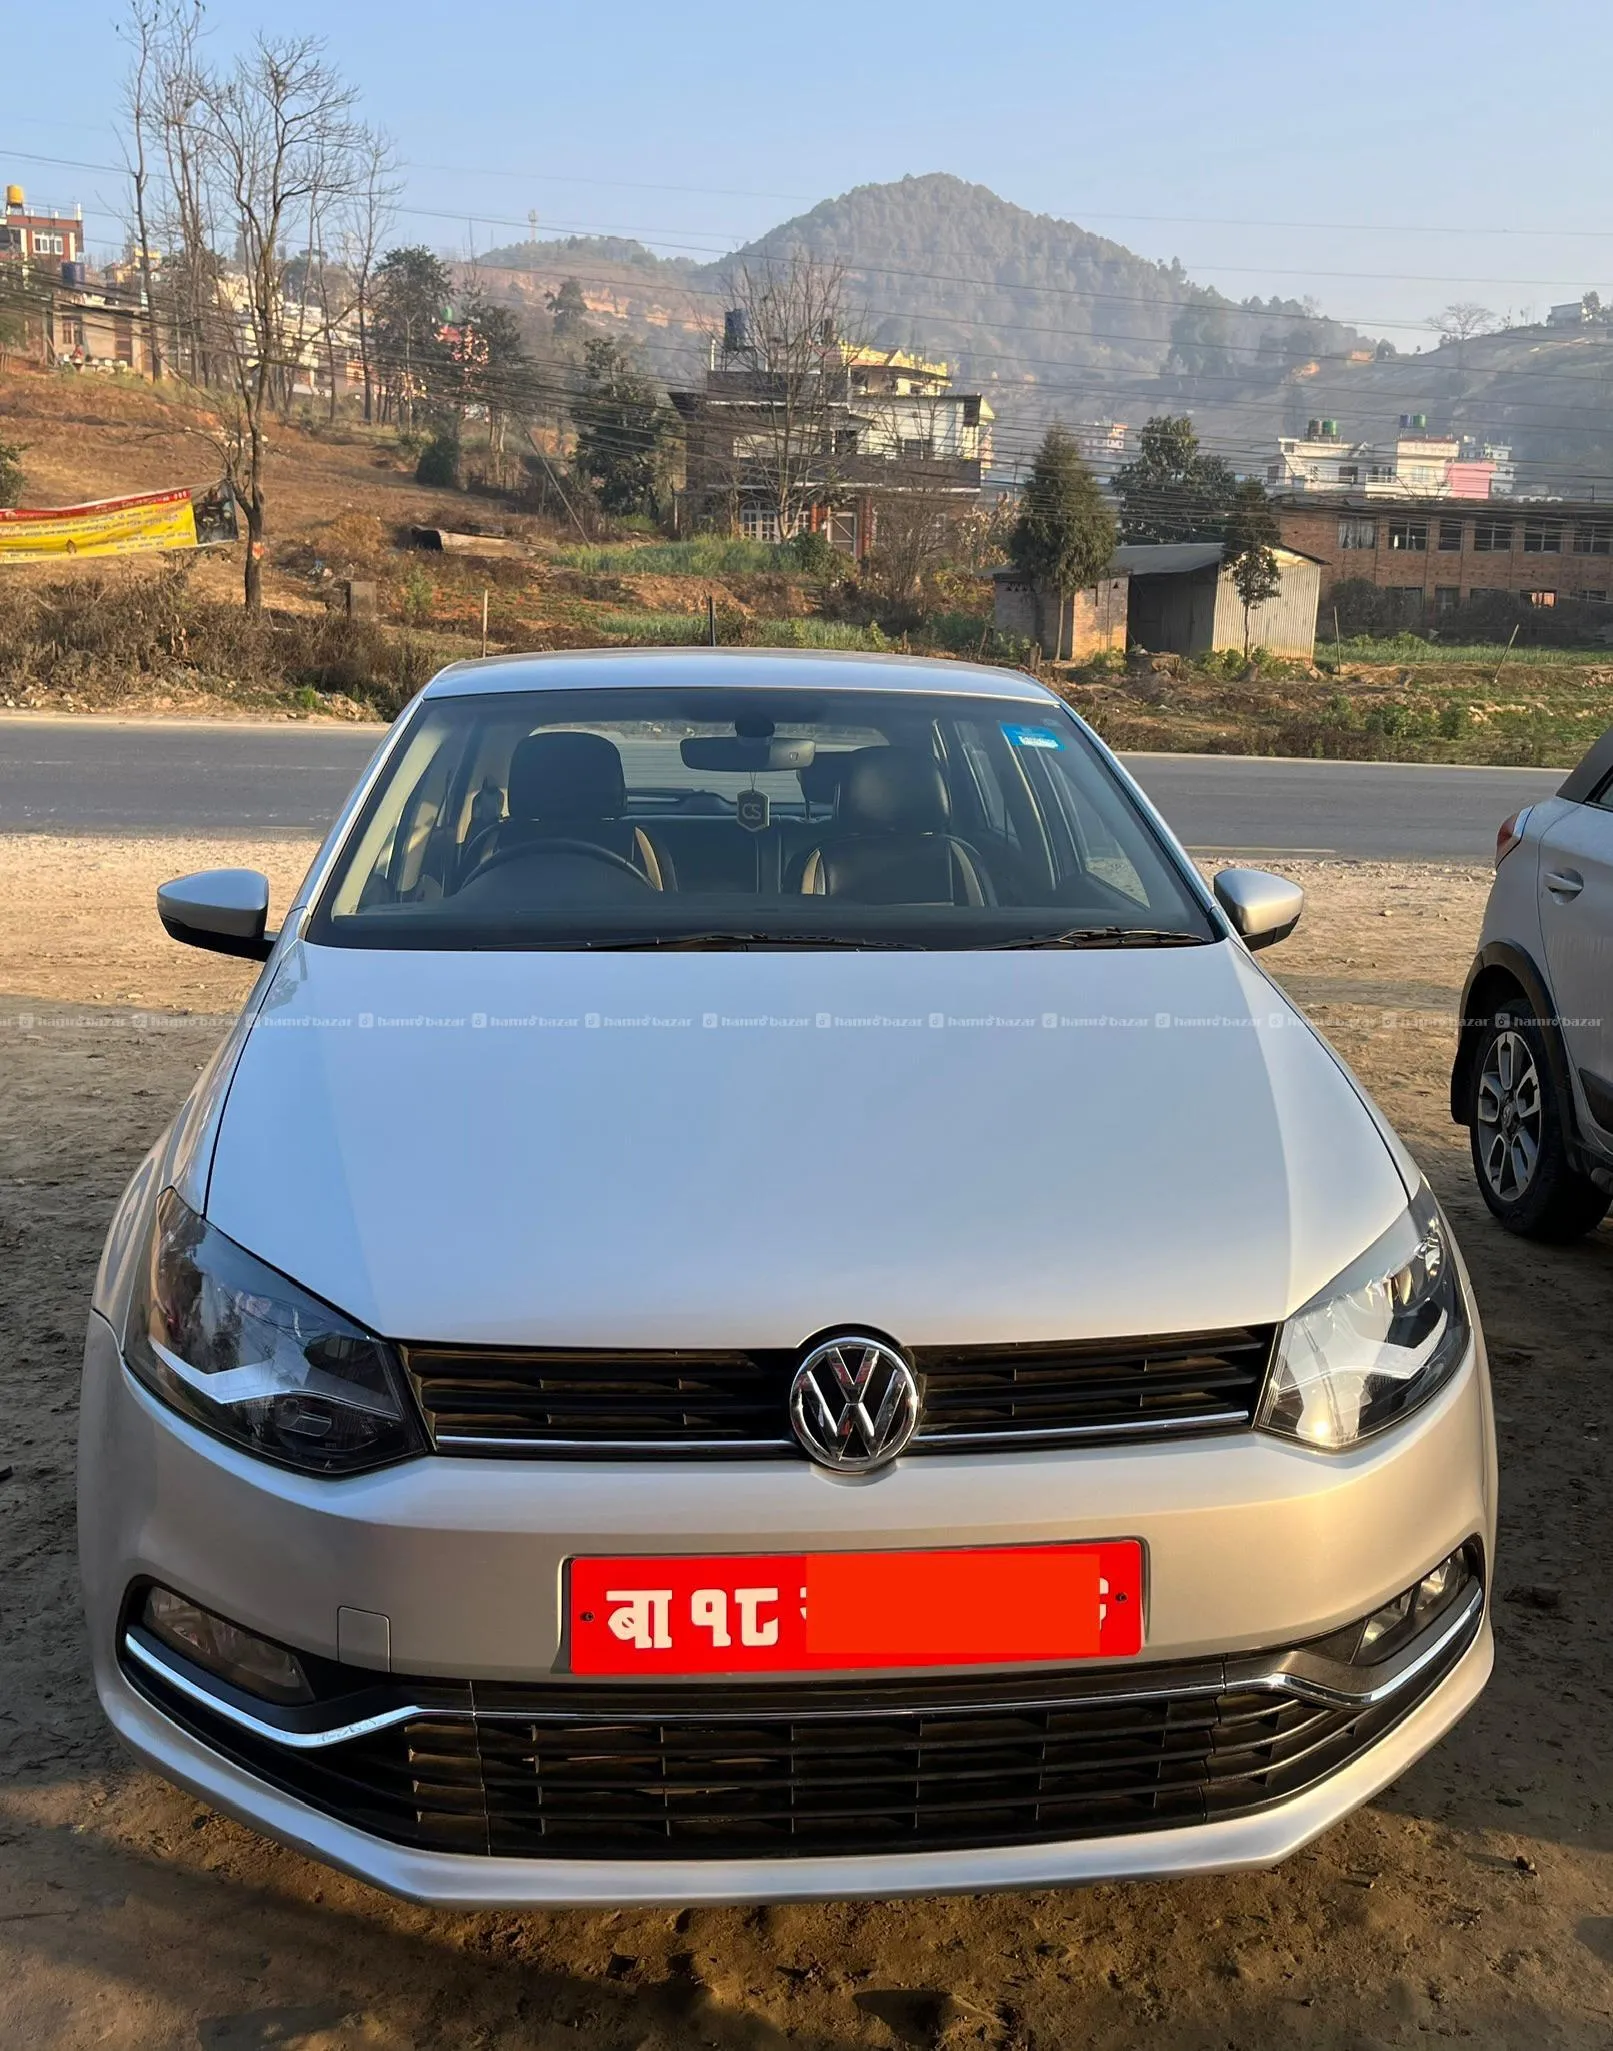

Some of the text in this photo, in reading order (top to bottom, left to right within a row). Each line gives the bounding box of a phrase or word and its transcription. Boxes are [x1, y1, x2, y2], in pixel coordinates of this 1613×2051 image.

[794, 1342, 913, 1466] VW
[606, 1589, 673, 1649] बा
[690, 1587, 779, 1647] १८
